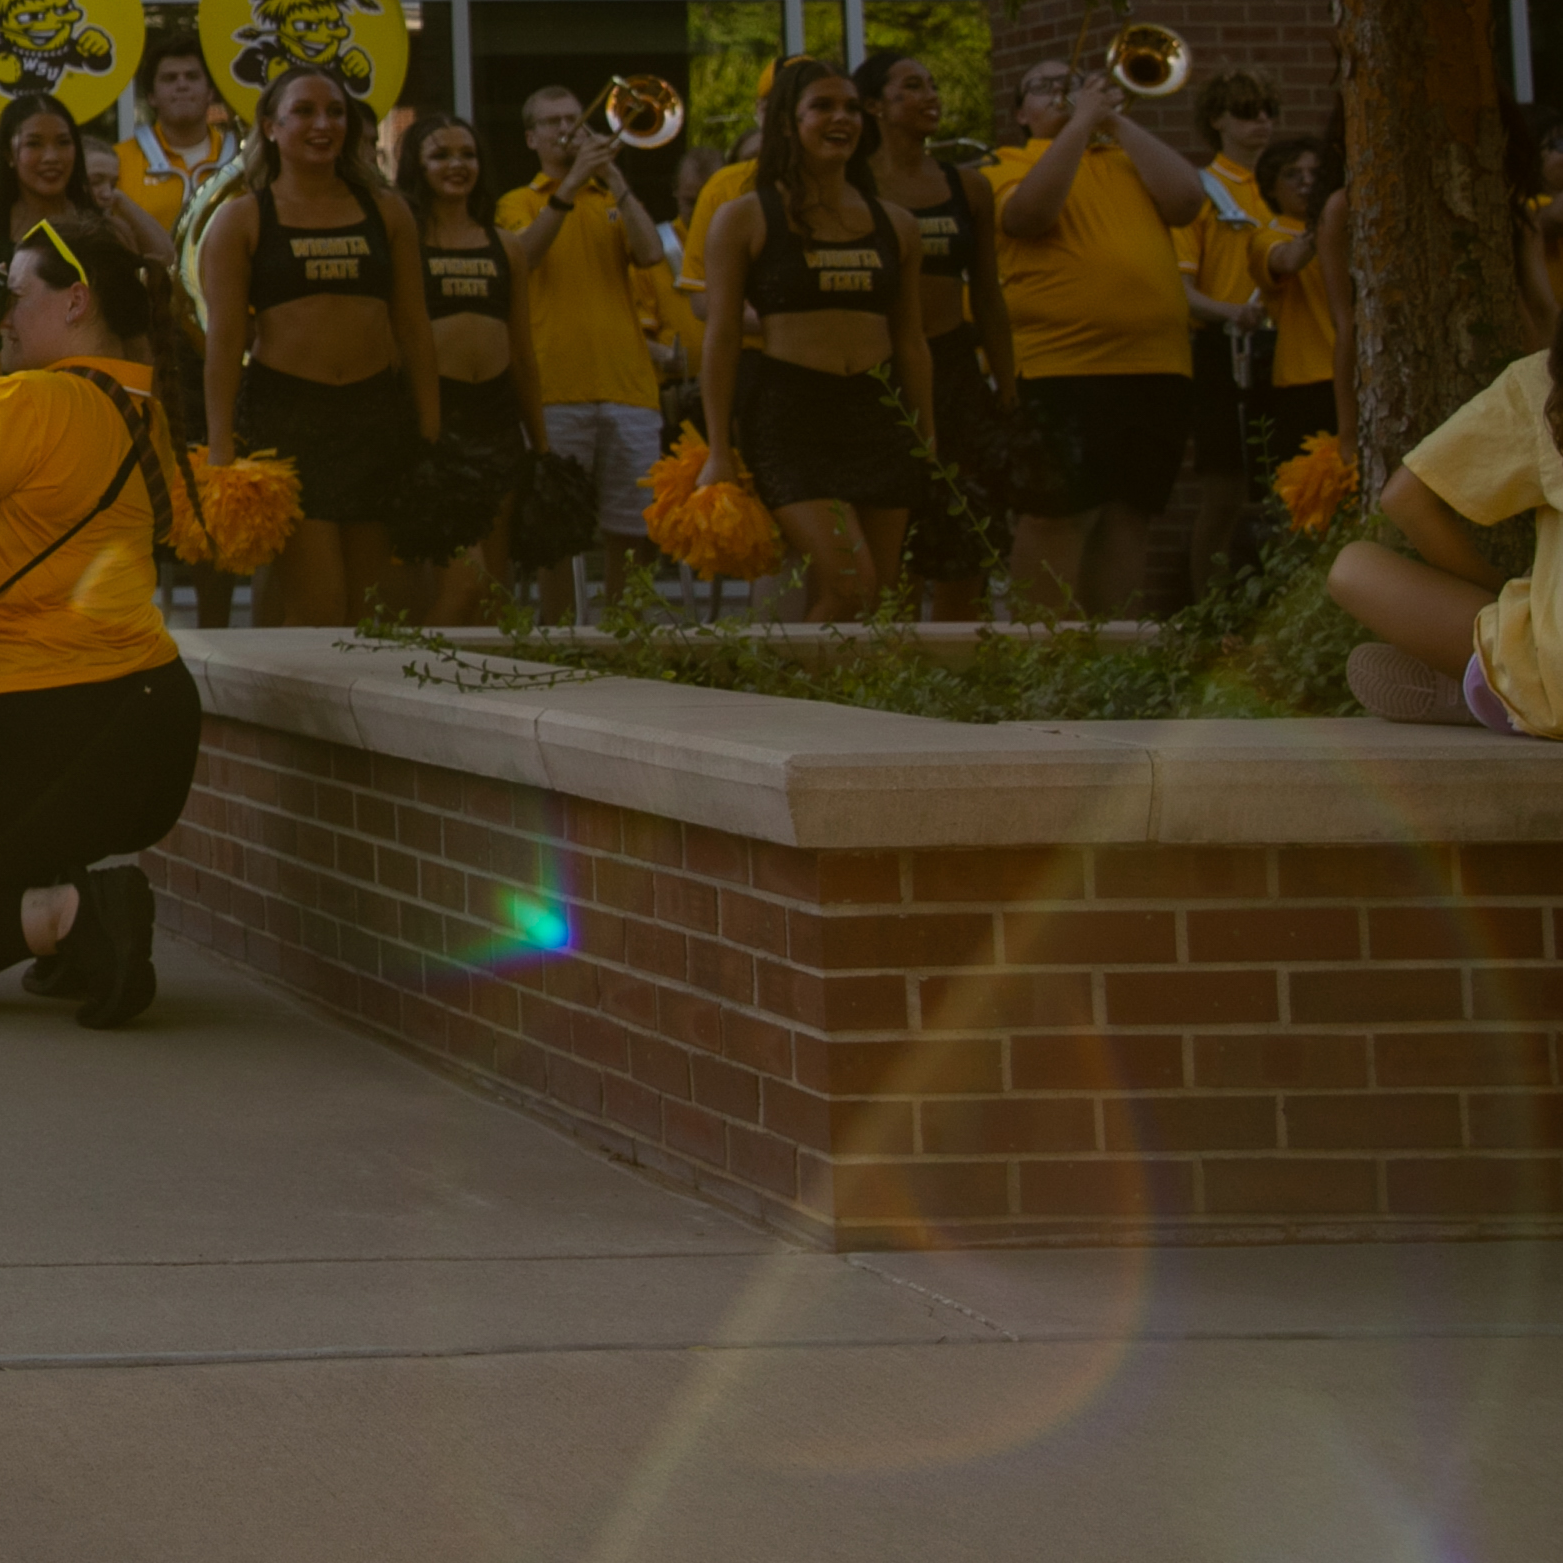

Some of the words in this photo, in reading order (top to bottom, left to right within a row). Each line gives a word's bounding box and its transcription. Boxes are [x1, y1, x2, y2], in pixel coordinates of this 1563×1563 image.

[23, 57, 60, 81] WSU
[290, 237, 370, 257] WICHITA
[305, 259, 359, 279] STATE
[428, 258, 498, 277] WICHITA
[441, 279, 488, 297] STATE
[819, 271, 872, 291] STATE
